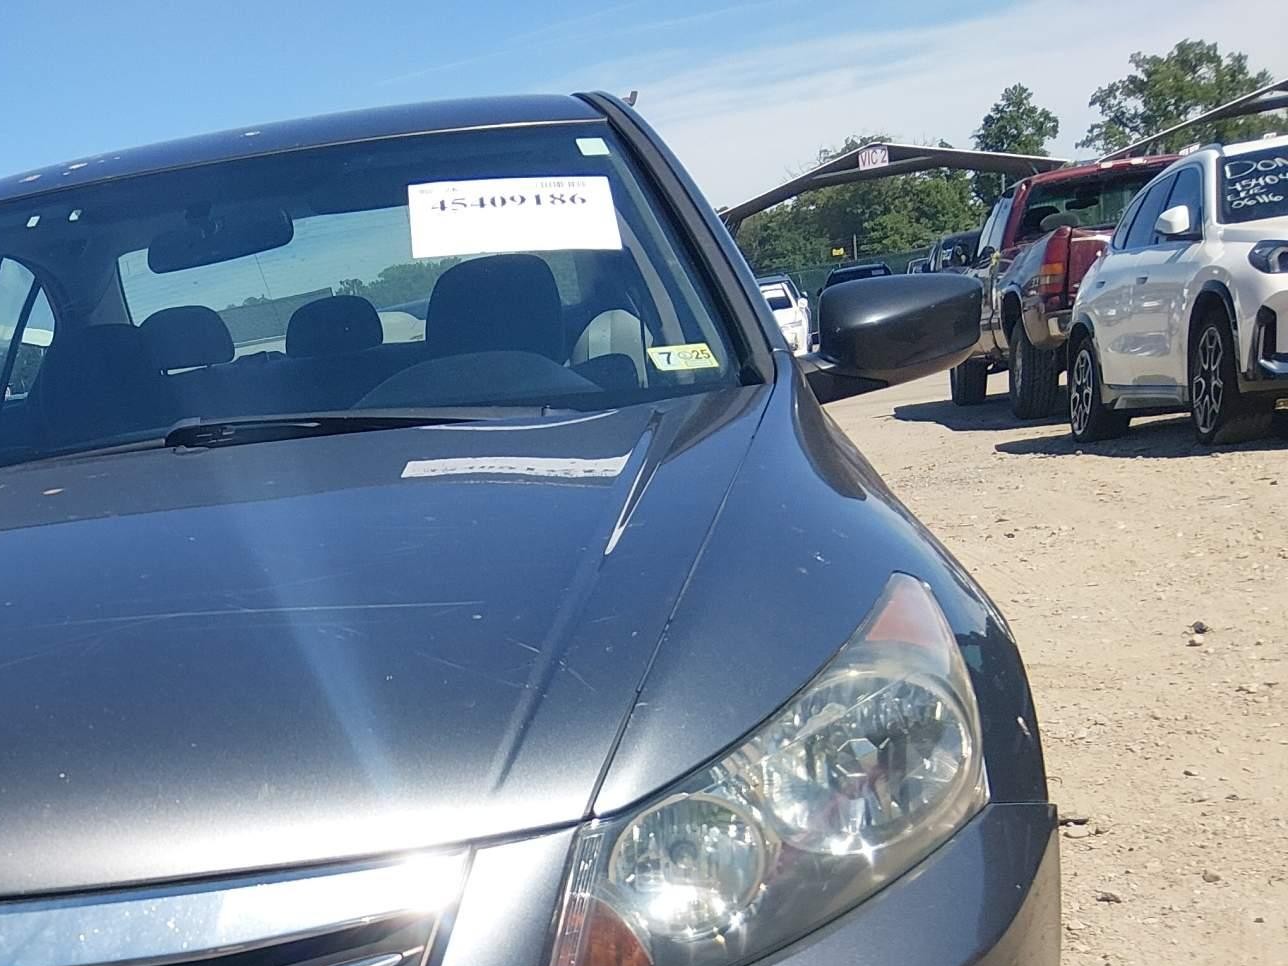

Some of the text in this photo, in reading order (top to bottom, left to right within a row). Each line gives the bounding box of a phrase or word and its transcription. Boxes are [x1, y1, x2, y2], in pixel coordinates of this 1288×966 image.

[881, 148, 888, 164] 2
[431, 192, 587, 212] 45409186
[658, 351, 672, 365] 7
[691, 348, 711, 360] 25
